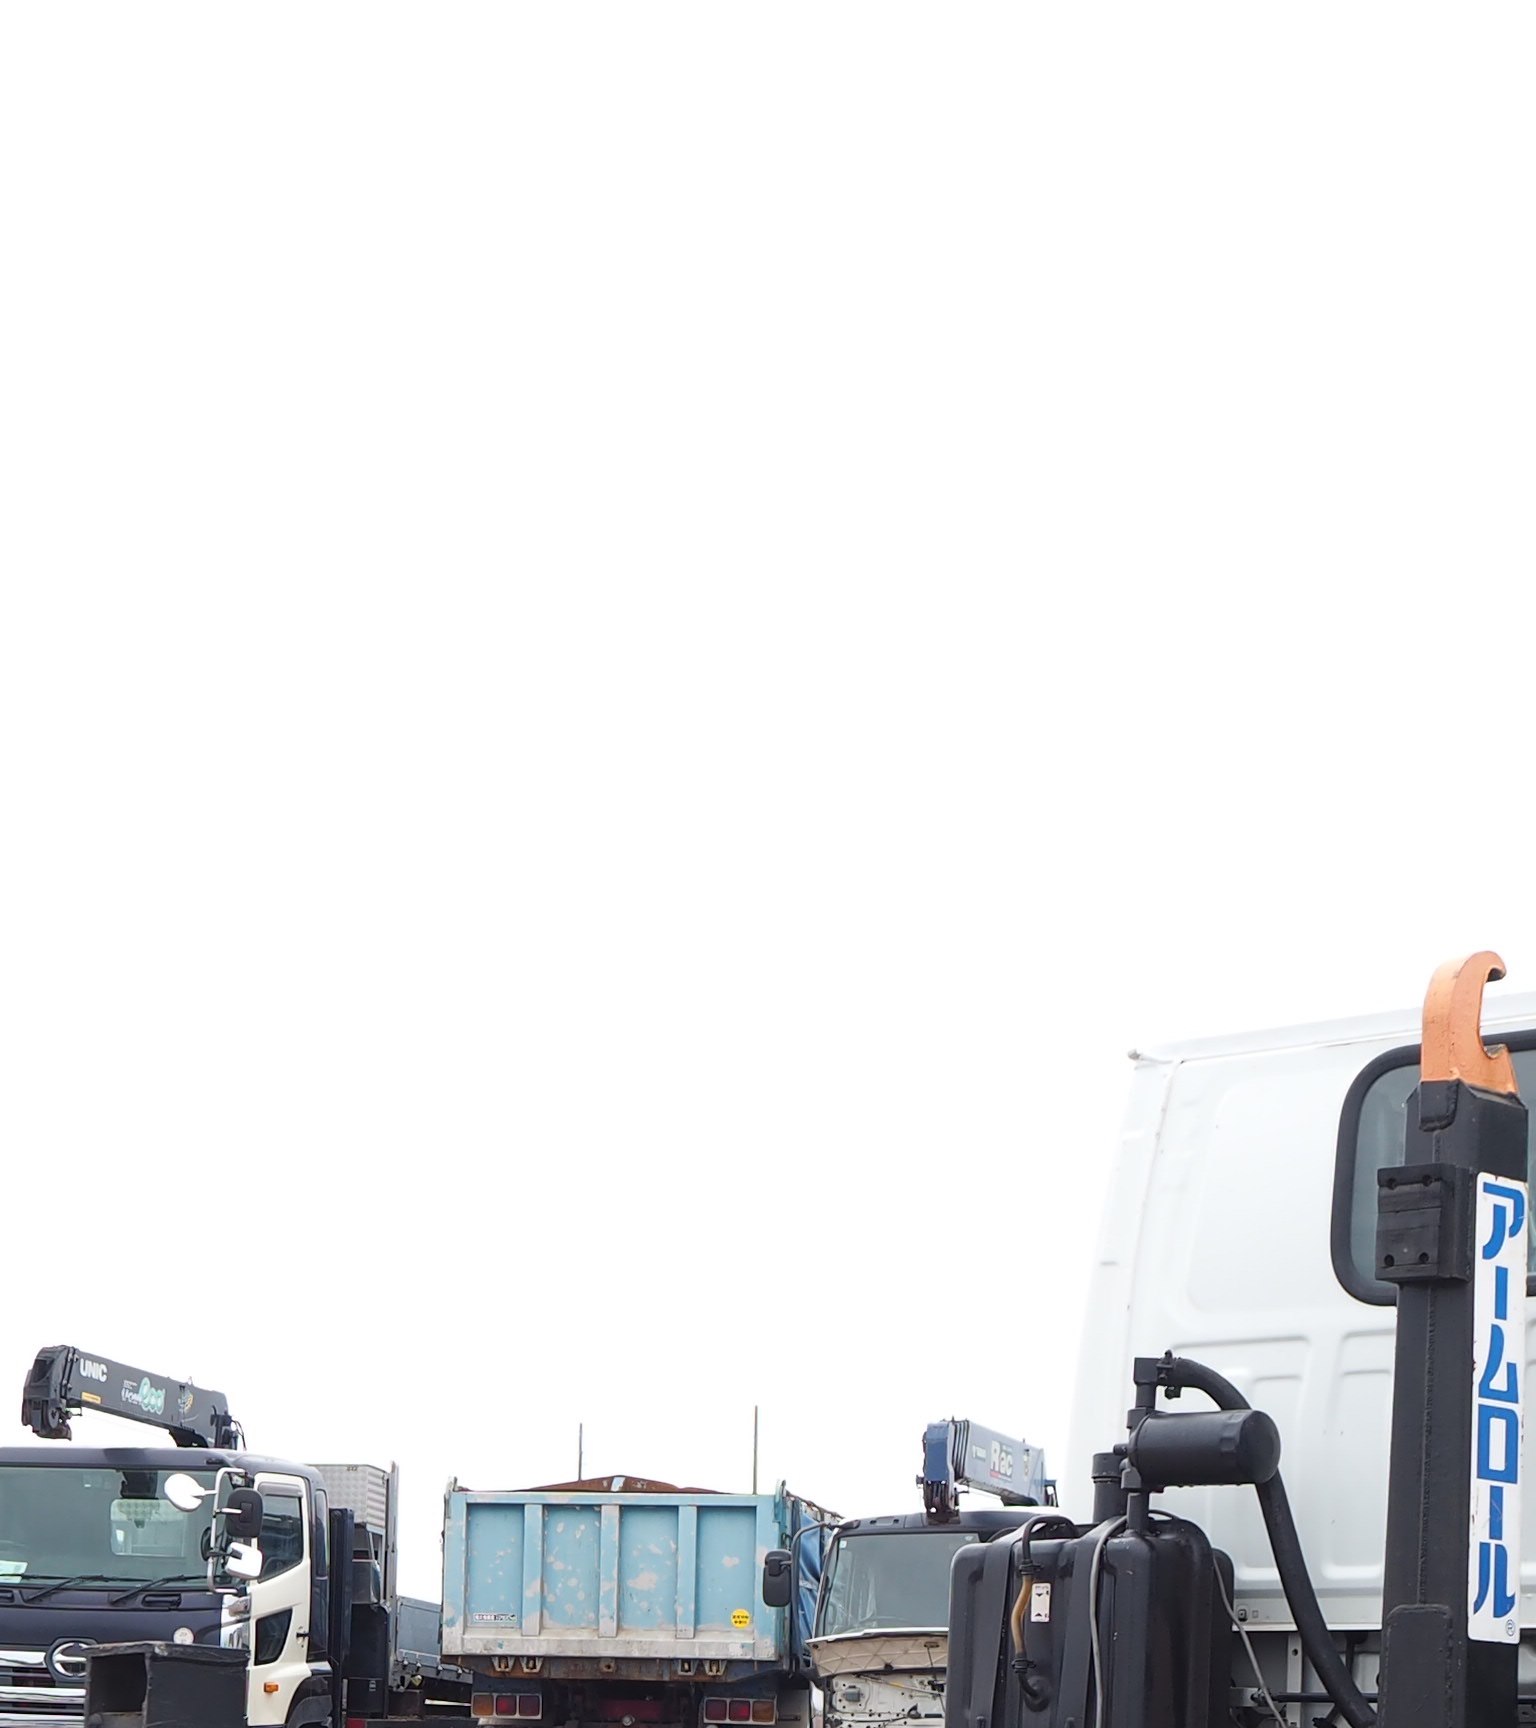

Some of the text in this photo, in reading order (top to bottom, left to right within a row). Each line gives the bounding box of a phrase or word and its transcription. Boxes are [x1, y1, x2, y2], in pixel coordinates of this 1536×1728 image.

[80, 1358, 107, 1382] UNIC
[1473, 1181, 1526, 1618] アームロール
[991, 1440, 1012, 1476] Rac
